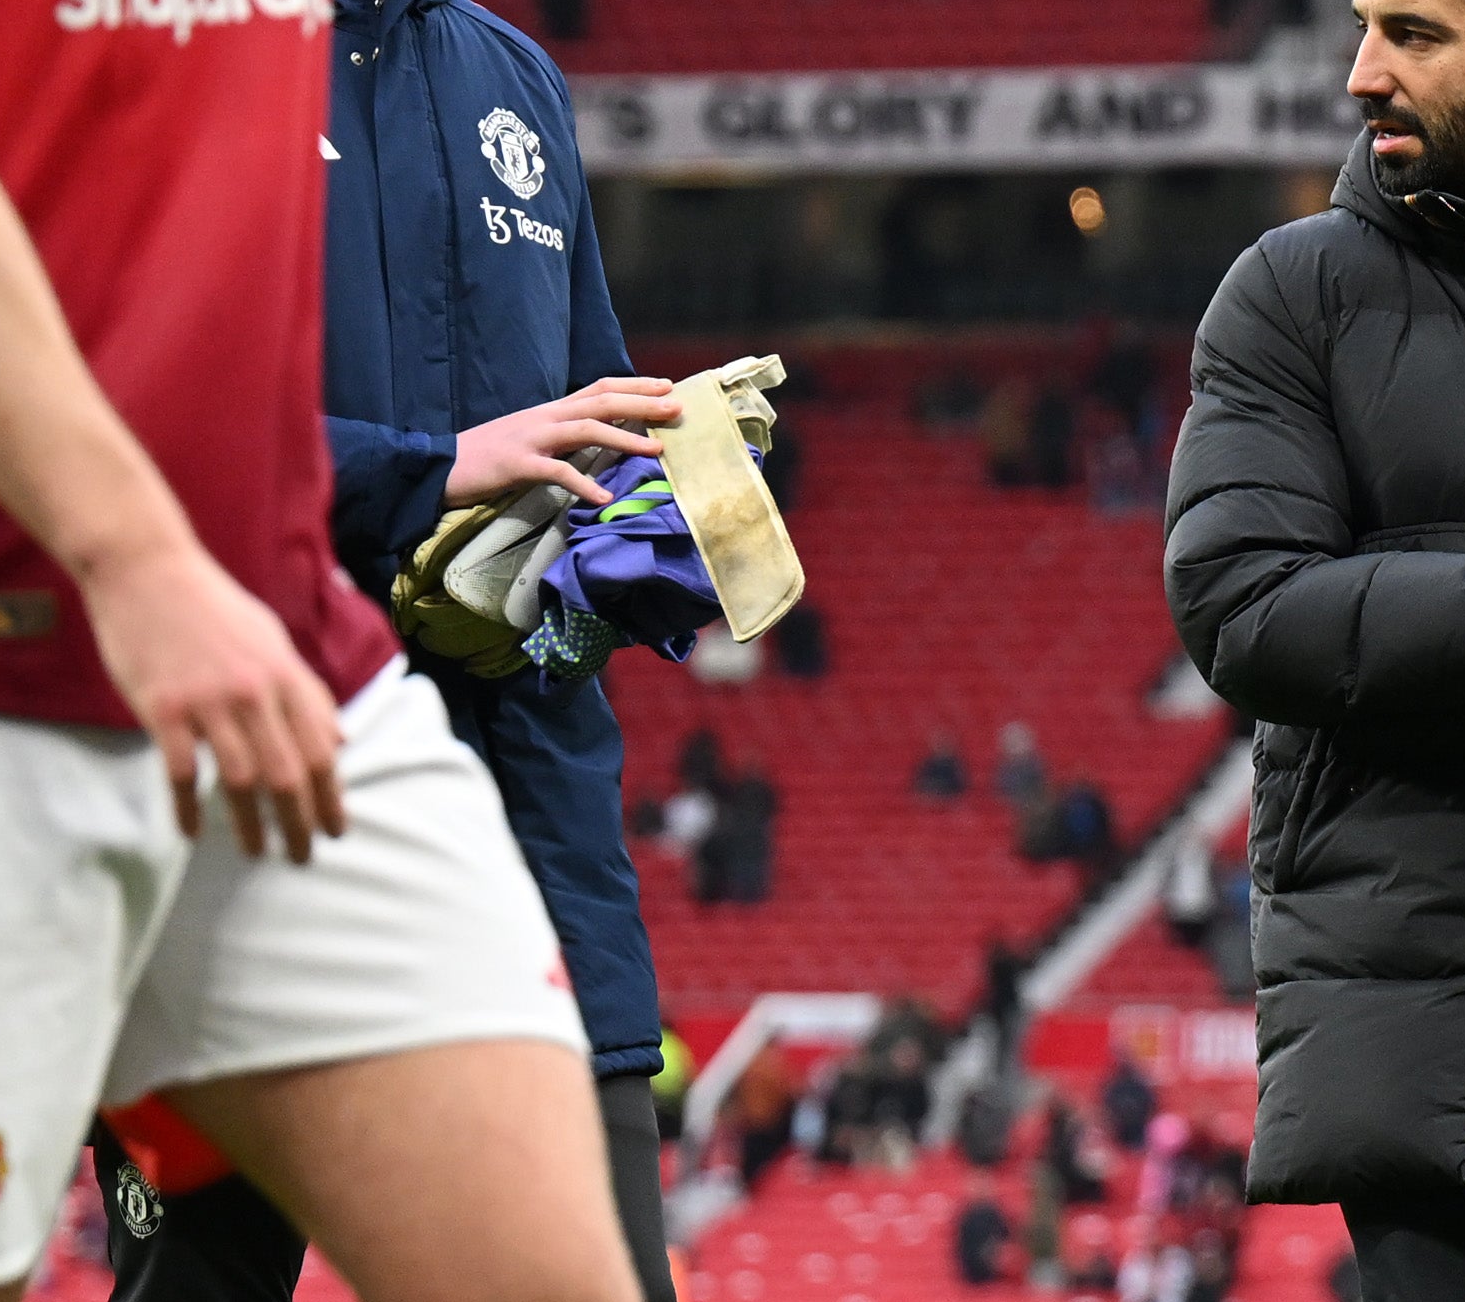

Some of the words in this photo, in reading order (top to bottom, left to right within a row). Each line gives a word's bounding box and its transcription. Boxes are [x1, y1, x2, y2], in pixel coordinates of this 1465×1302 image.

[703, 80, 982, 143] GLORY
[1034, 81, 1212, 139] AND
[509, 208, 564, 251] Tezos
